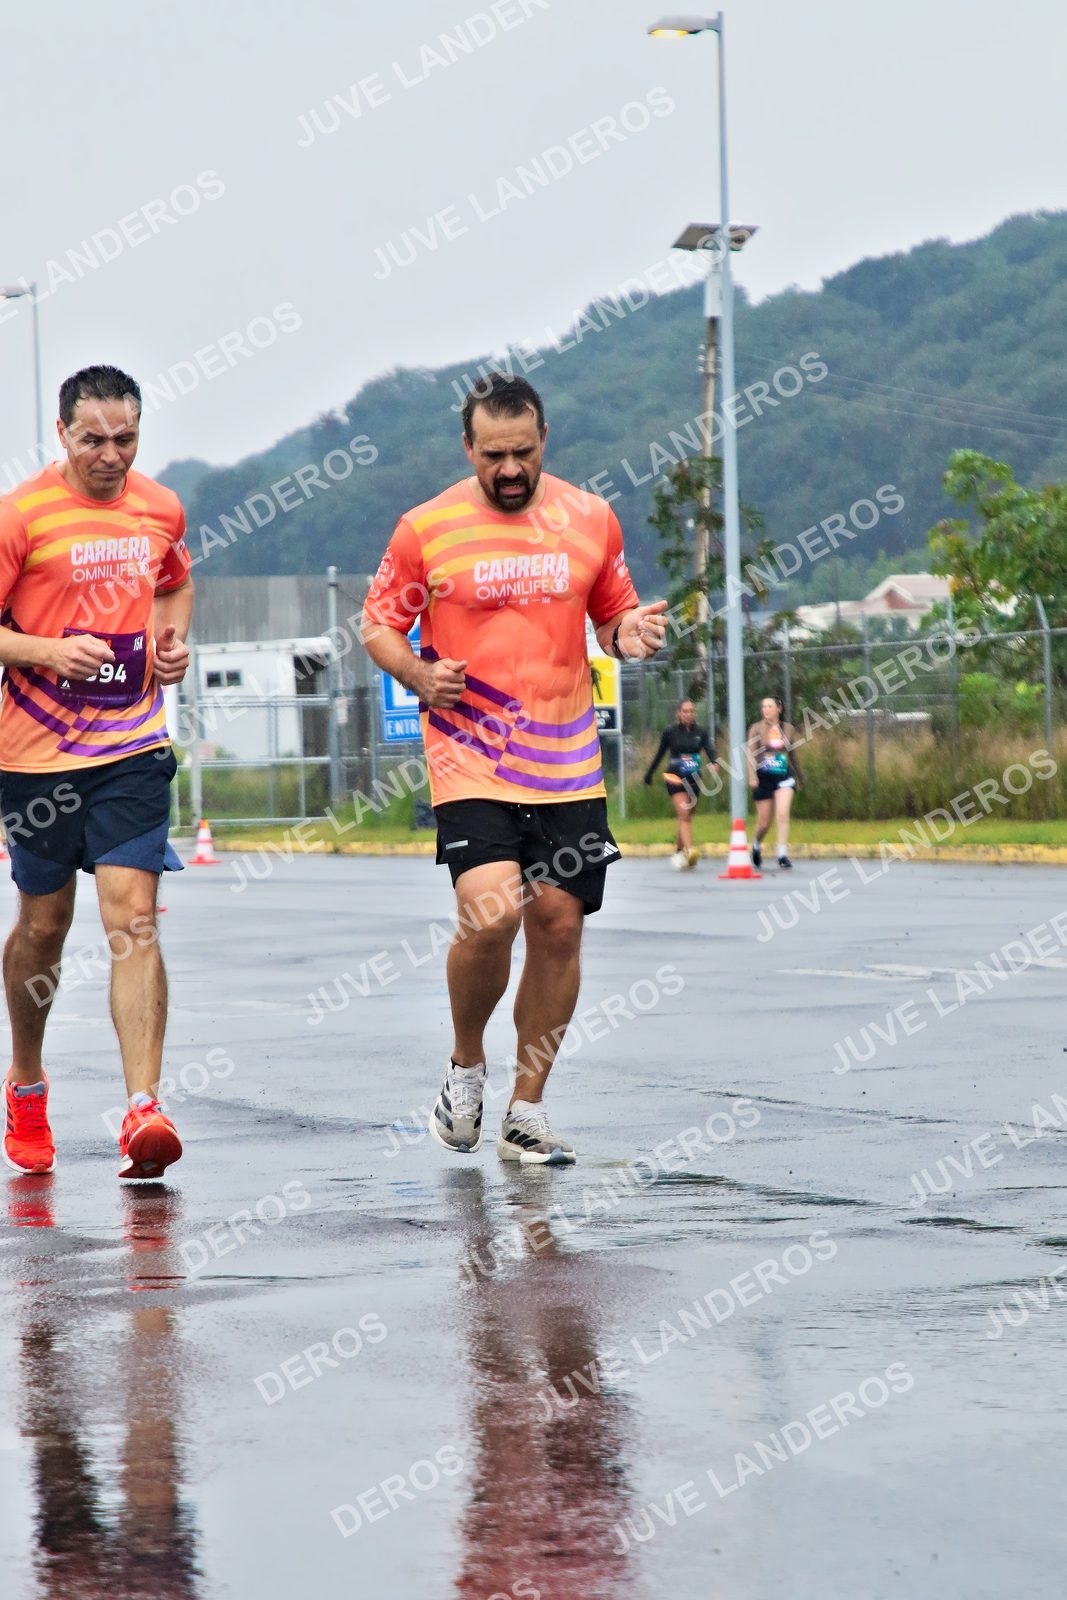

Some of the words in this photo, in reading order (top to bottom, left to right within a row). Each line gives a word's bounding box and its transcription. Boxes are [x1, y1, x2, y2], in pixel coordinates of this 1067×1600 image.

[71, 536, 151, 566] CARRERA
[73, 562, 135, 583] OMNILIFE
[473, 552, 570, 583] CARRERA
[476, 578, 550, 600] OMNILIFE
[133, 635, 144, 651] 15K
[85, 663, 127, 683] 94
